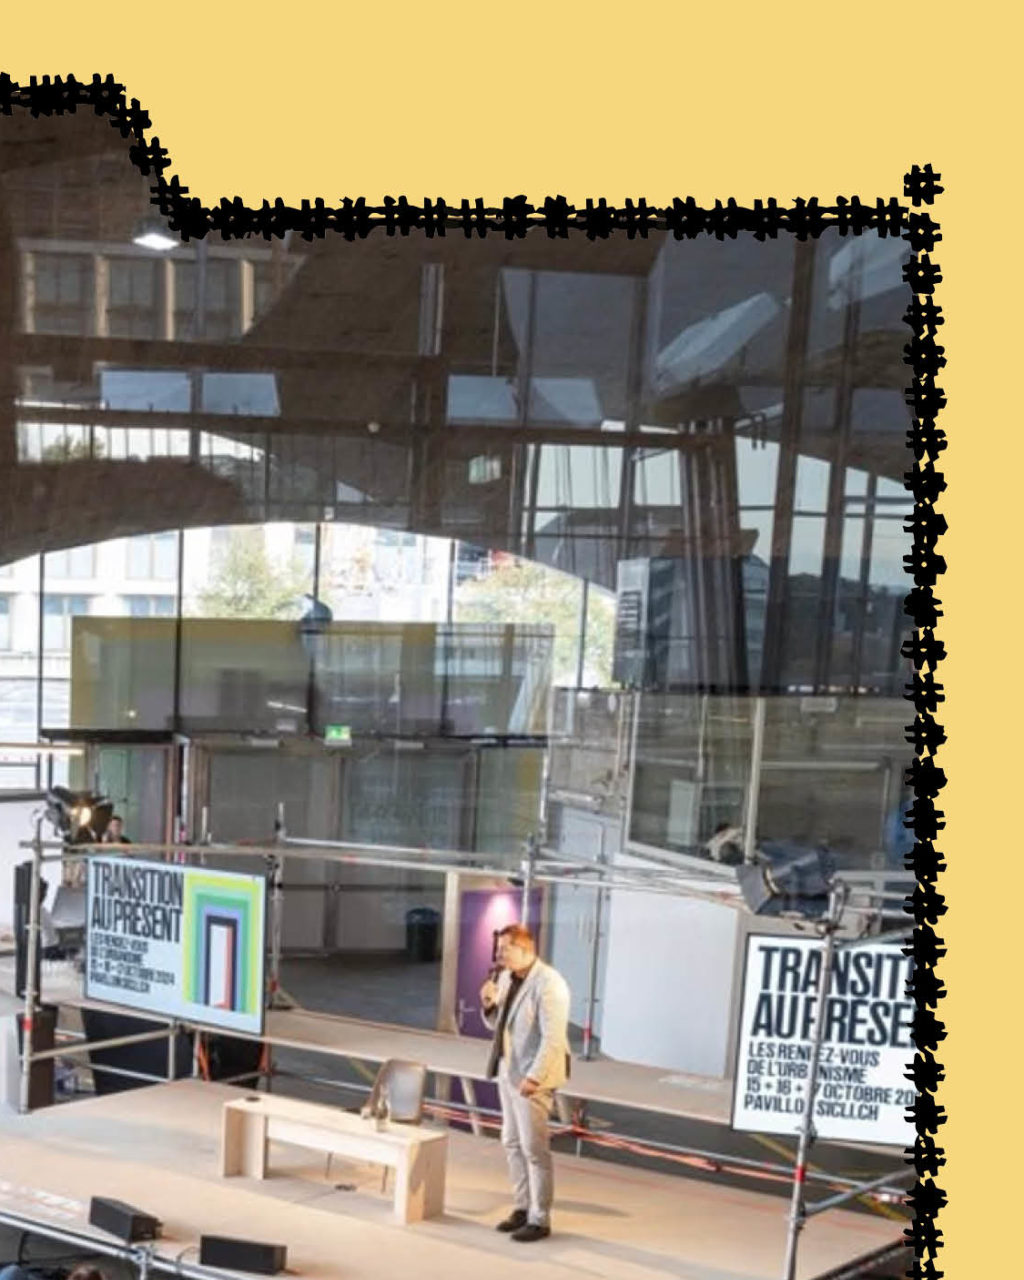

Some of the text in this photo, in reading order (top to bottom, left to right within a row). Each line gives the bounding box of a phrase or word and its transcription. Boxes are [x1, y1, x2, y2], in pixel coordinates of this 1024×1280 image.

[93, 861, 183, 907] TRANSITION
[93, 896, 113, 930] AU
[751, 993, 917, 1048] AU PRESE
[748, 1041, 775, 1058] LES
[747, 1059, 867, 1083] DE L'URBNISME
[747, 1076, 761, 1092] 15
[823, 1083, 893, 1104] OCTOBRE
[895, 1089, 919, 1106] 20
